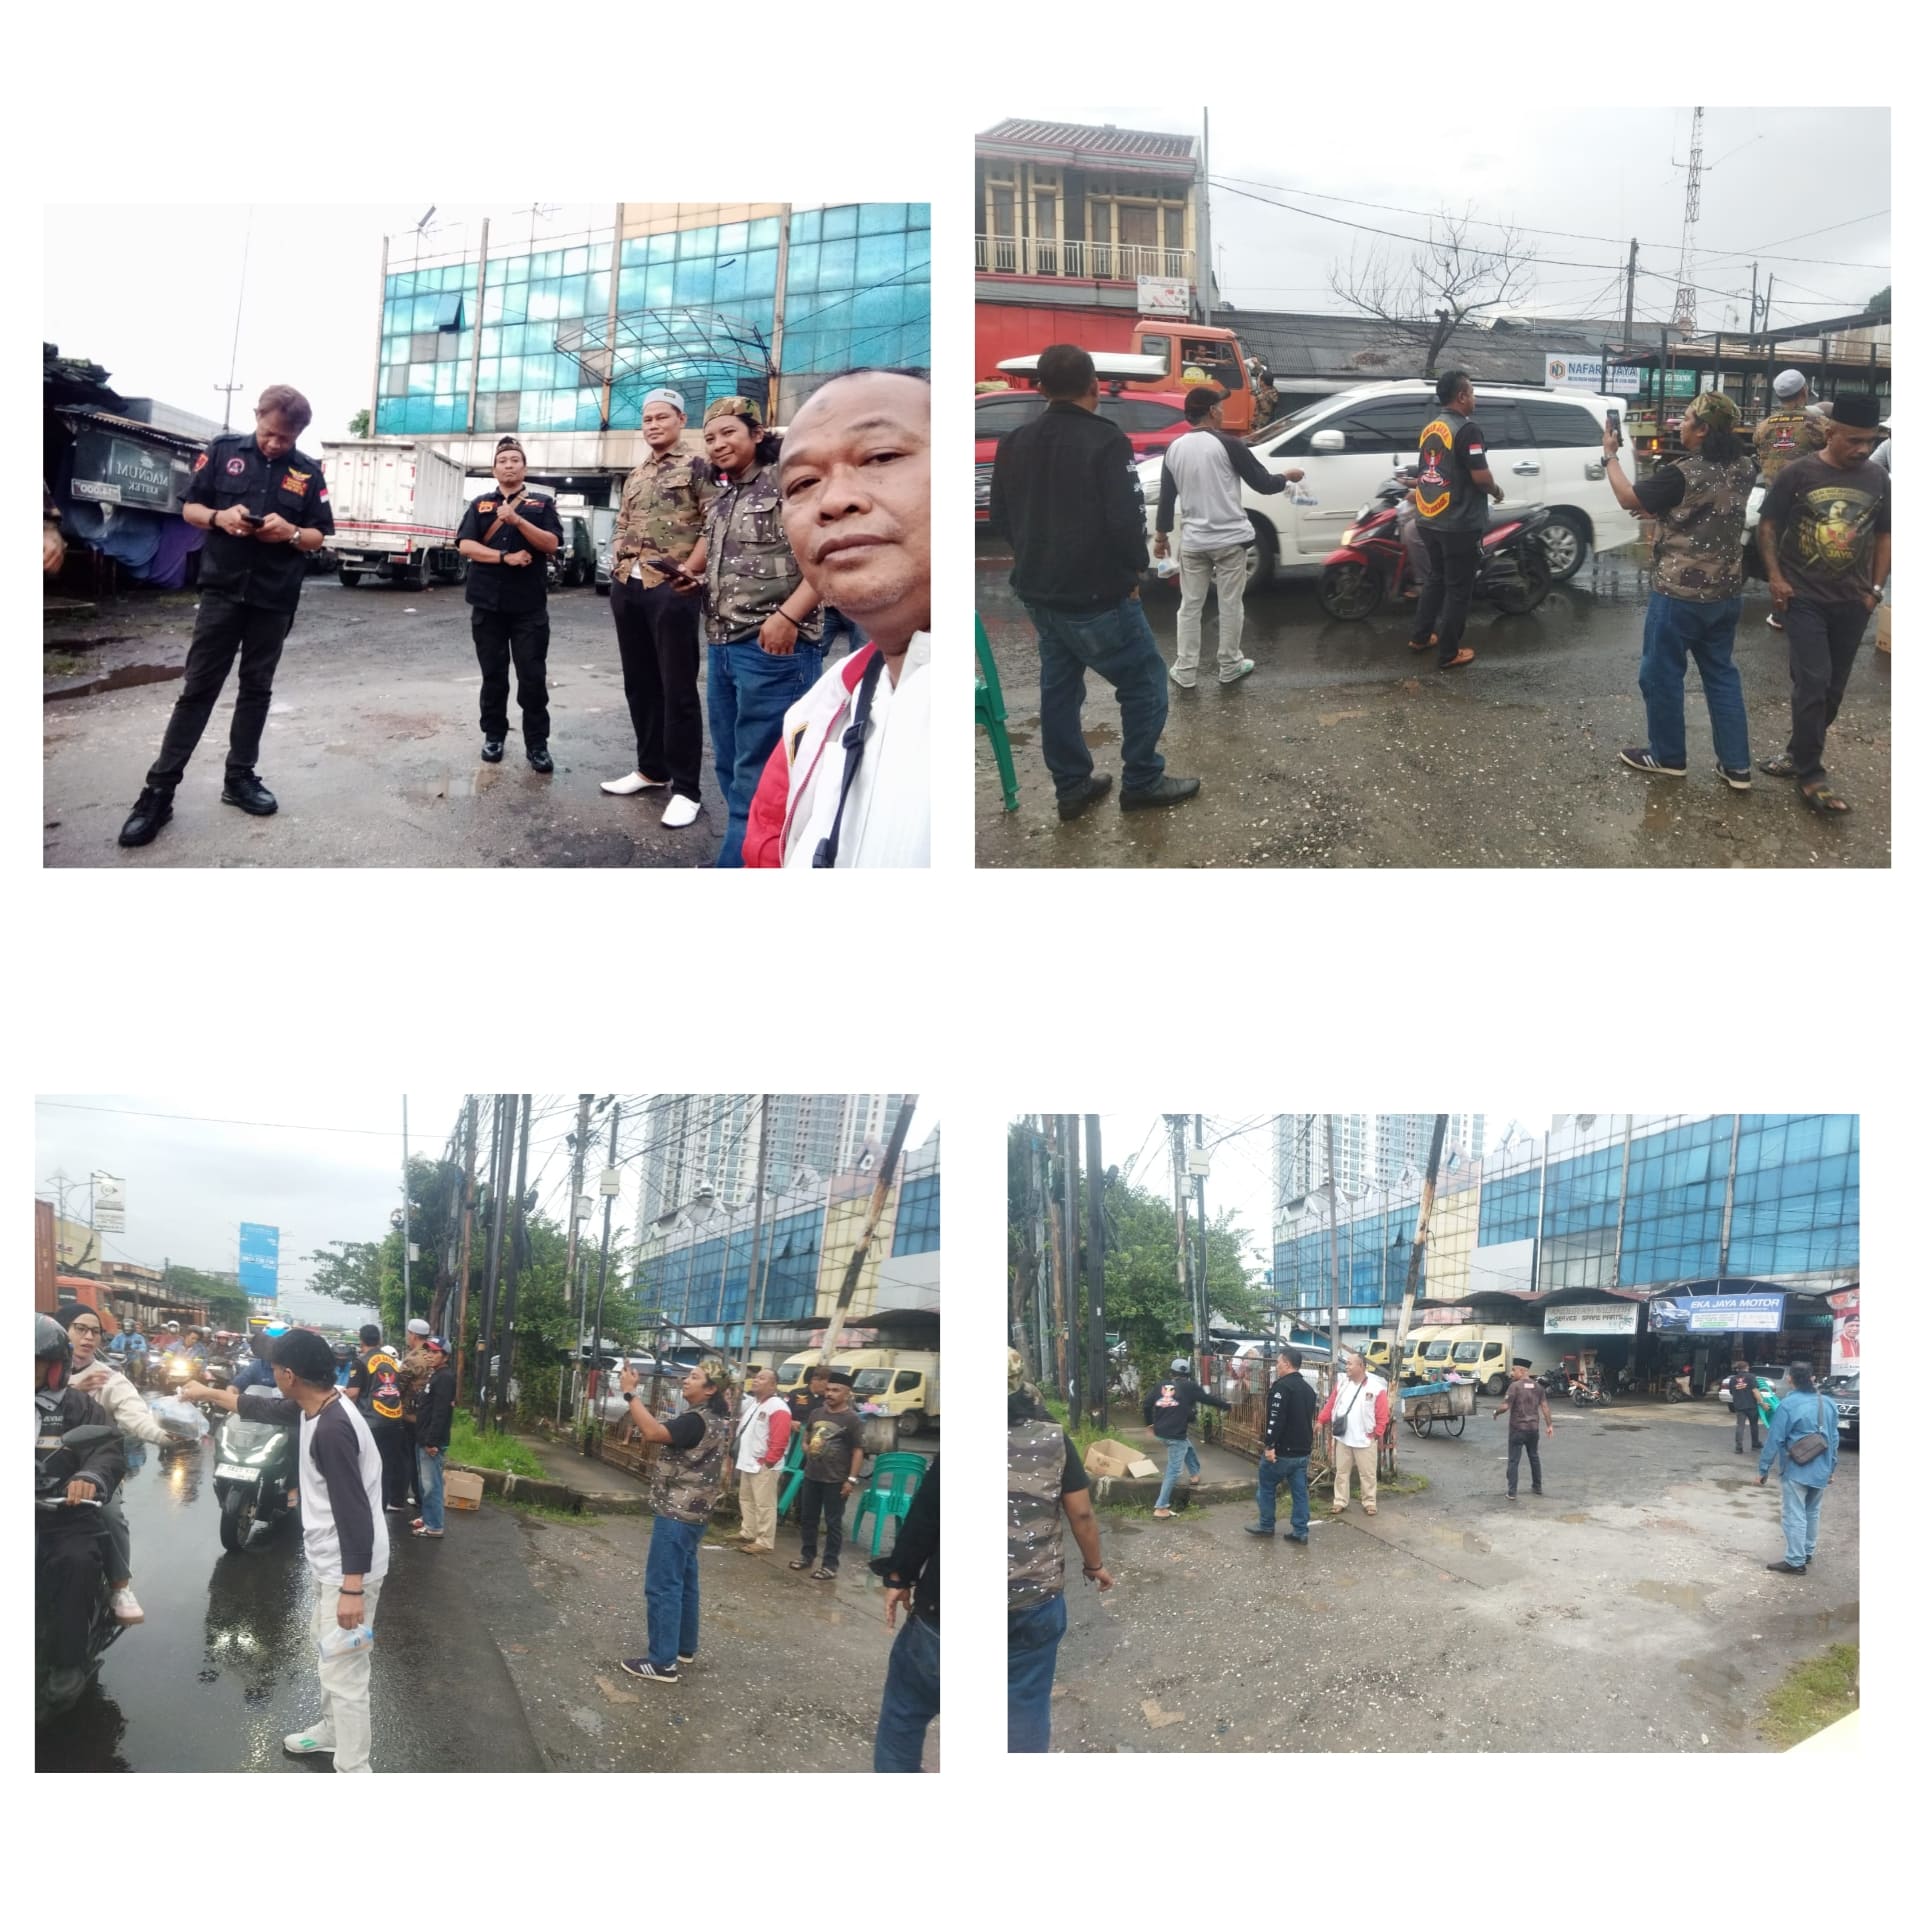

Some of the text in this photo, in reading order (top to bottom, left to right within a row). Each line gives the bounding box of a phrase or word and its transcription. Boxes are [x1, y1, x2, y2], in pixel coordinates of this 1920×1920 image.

[1612, 366, 1637, 377] AYA
[1711, 1300, 1737, 1308] JAYA
[1739, 1298, 1780, 1307] MOTOR
